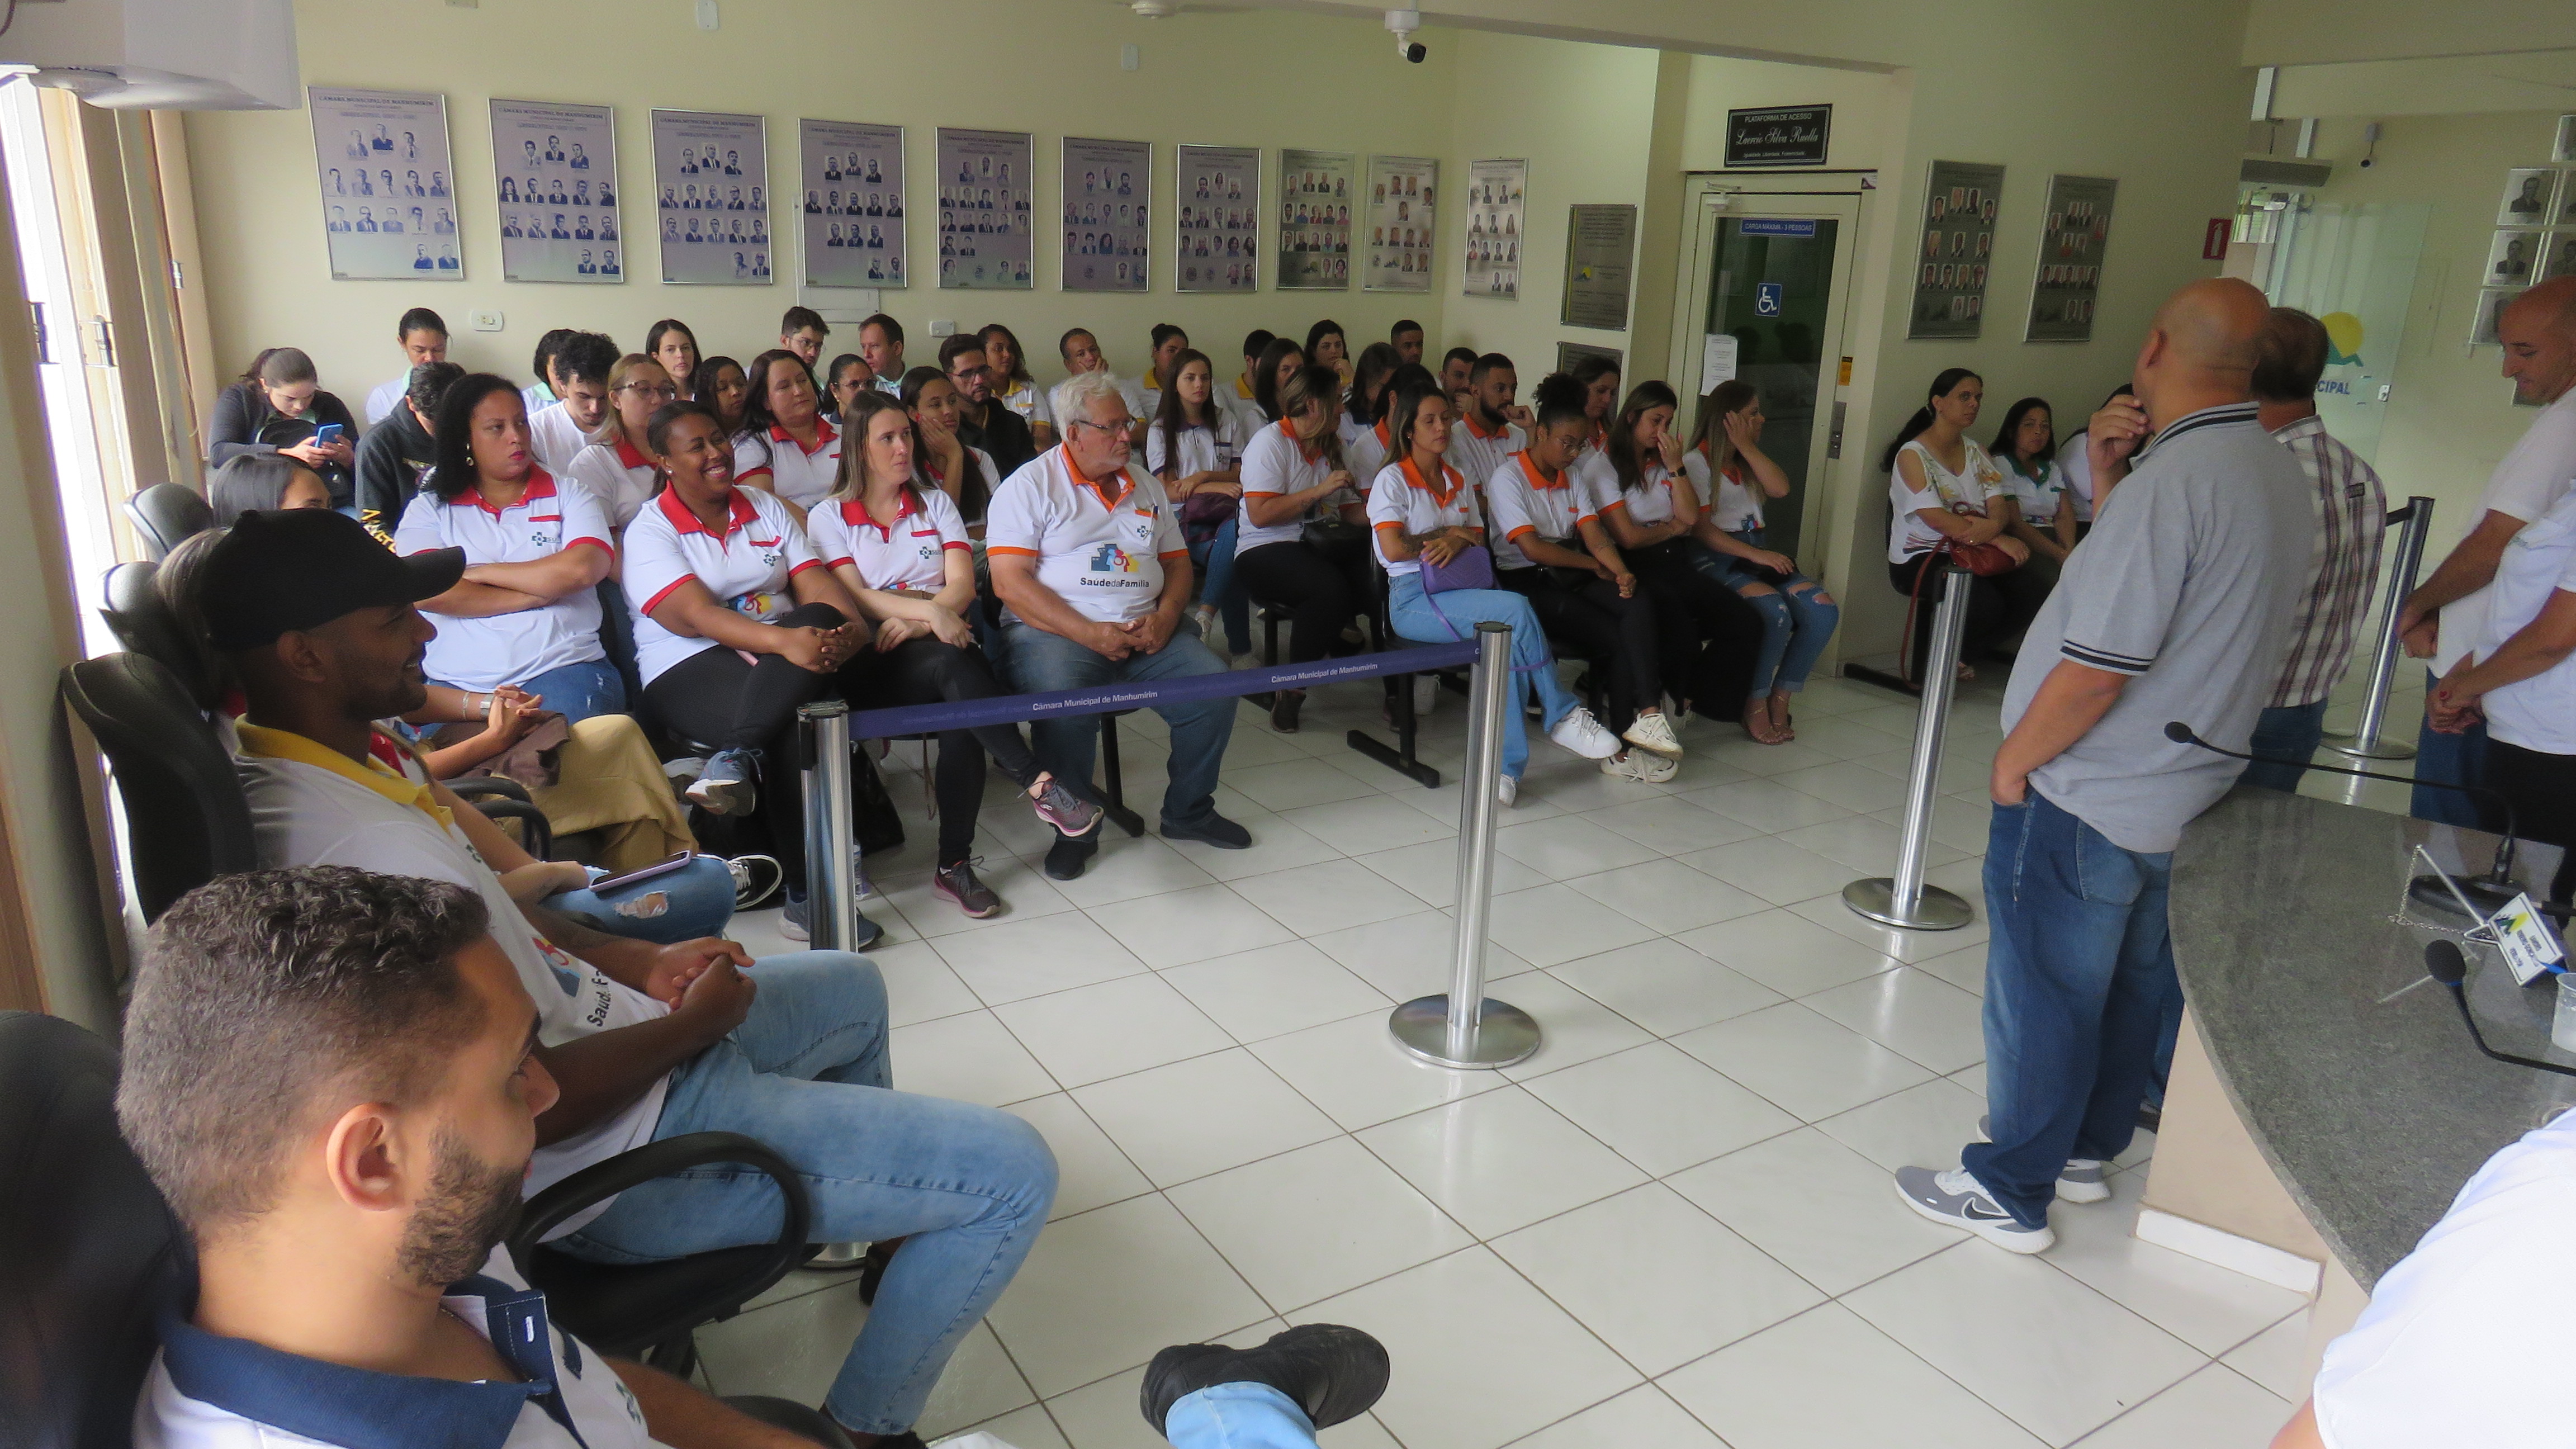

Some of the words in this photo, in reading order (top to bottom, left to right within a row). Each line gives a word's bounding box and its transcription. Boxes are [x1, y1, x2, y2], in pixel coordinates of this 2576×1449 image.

[1745, 115, 1779, 123] PLATAFORMA
[1765, 127, 1787, 144] Silva
[1271, 674, 1297, 683] Câmara
[1298, 670, 1329, 680] Municipal
[1339, 663, 1378, 674] Manhumirim
[1033, 701, 1063, 711] Câmara
[1064, 696, 1101, 707] Municipal
[1112, 691, 1158, 702] Manhumirim
